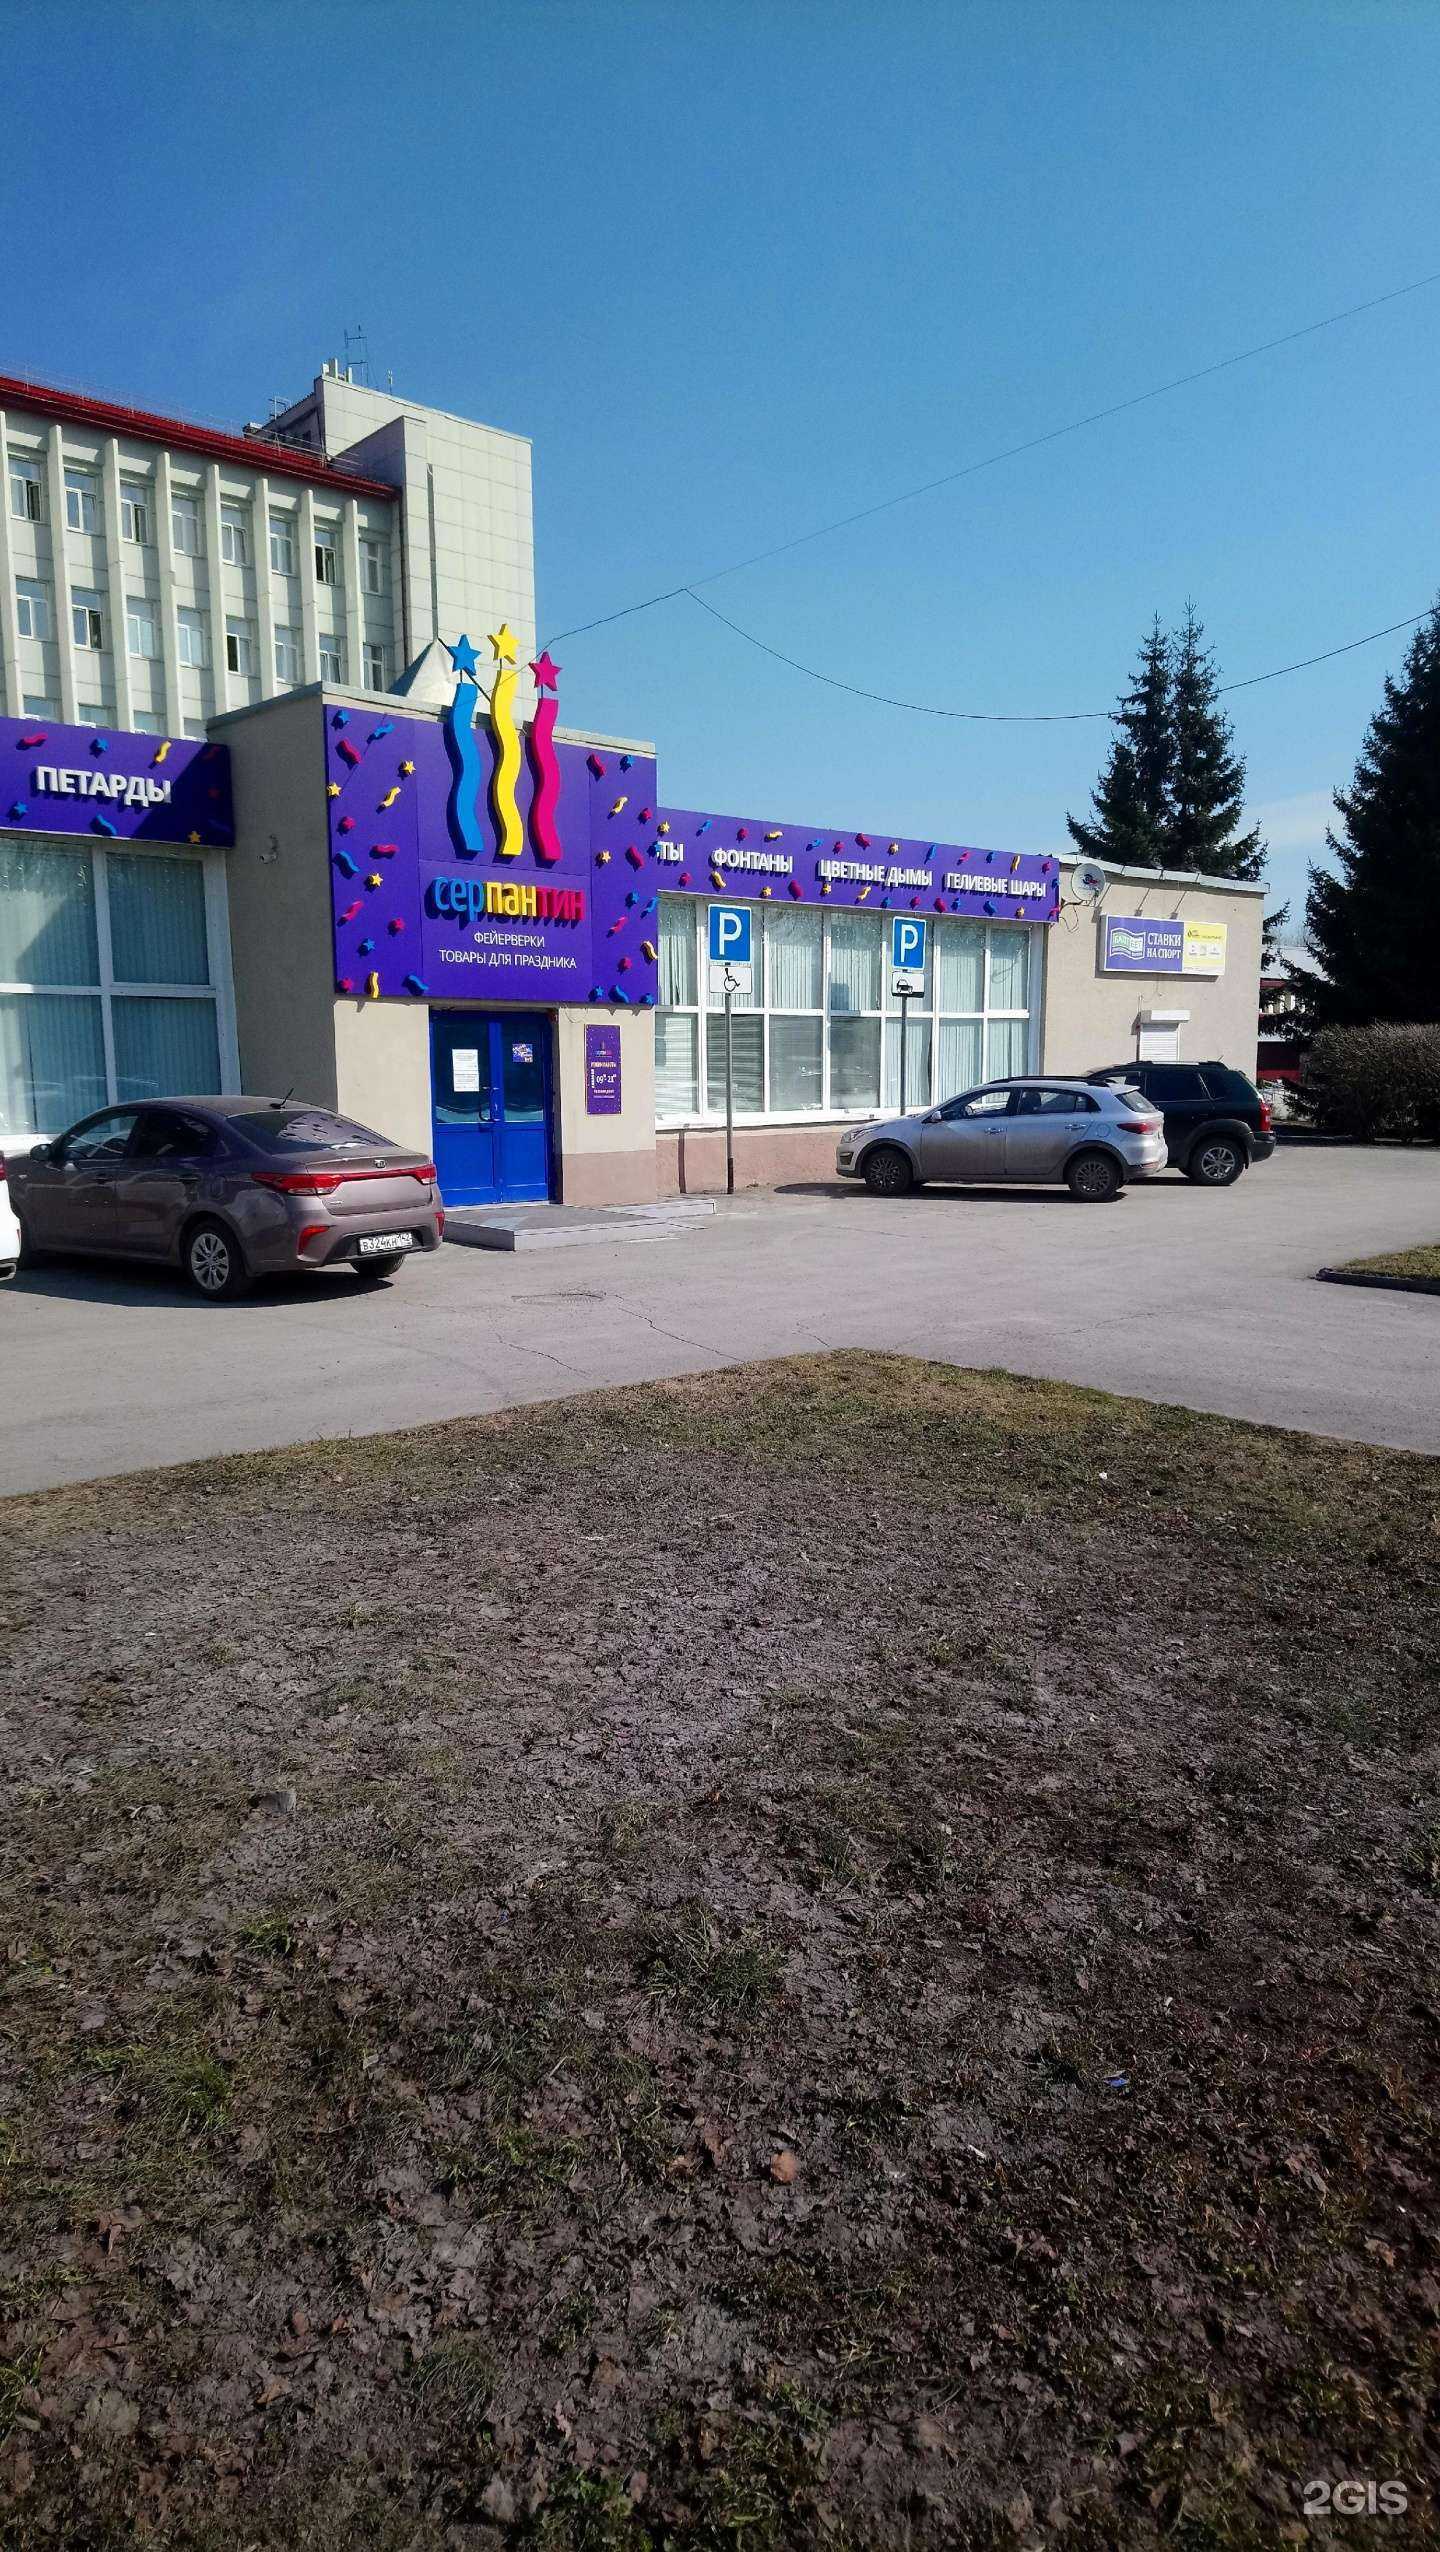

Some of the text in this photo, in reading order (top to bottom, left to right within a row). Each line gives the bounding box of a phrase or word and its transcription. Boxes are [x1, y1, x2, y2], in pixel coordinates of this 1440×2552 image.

[36, 765, 171, 807] ПЕТАРДЫ
[656, 840, 684, 862] ТЫ
[711, 847, 793, 873] ФОНТАНЫ
[818, 859, 932, 887] ЦВЕТНЫЕ ДЫМЫ
[945, 872, 1046, 897] ГЕЛИЕВЫЕ ШАРЫ
[434, 876, 585, 922] серпантин
[474, 929, 545, 947] ФЕЙЕРВЕРКИ
[719, 912, 742, 955] P
[901, 924, 918, 963] P
[1147, 933, 1182, 947] СТАВКИ
[439, 949, 577, 970] ТОВАРЫ ДЛЯ ПРАЗДНИКА
[1146, 948, 1157, 958] НА
[1157, 948, 1182, 959] СПОРТ
